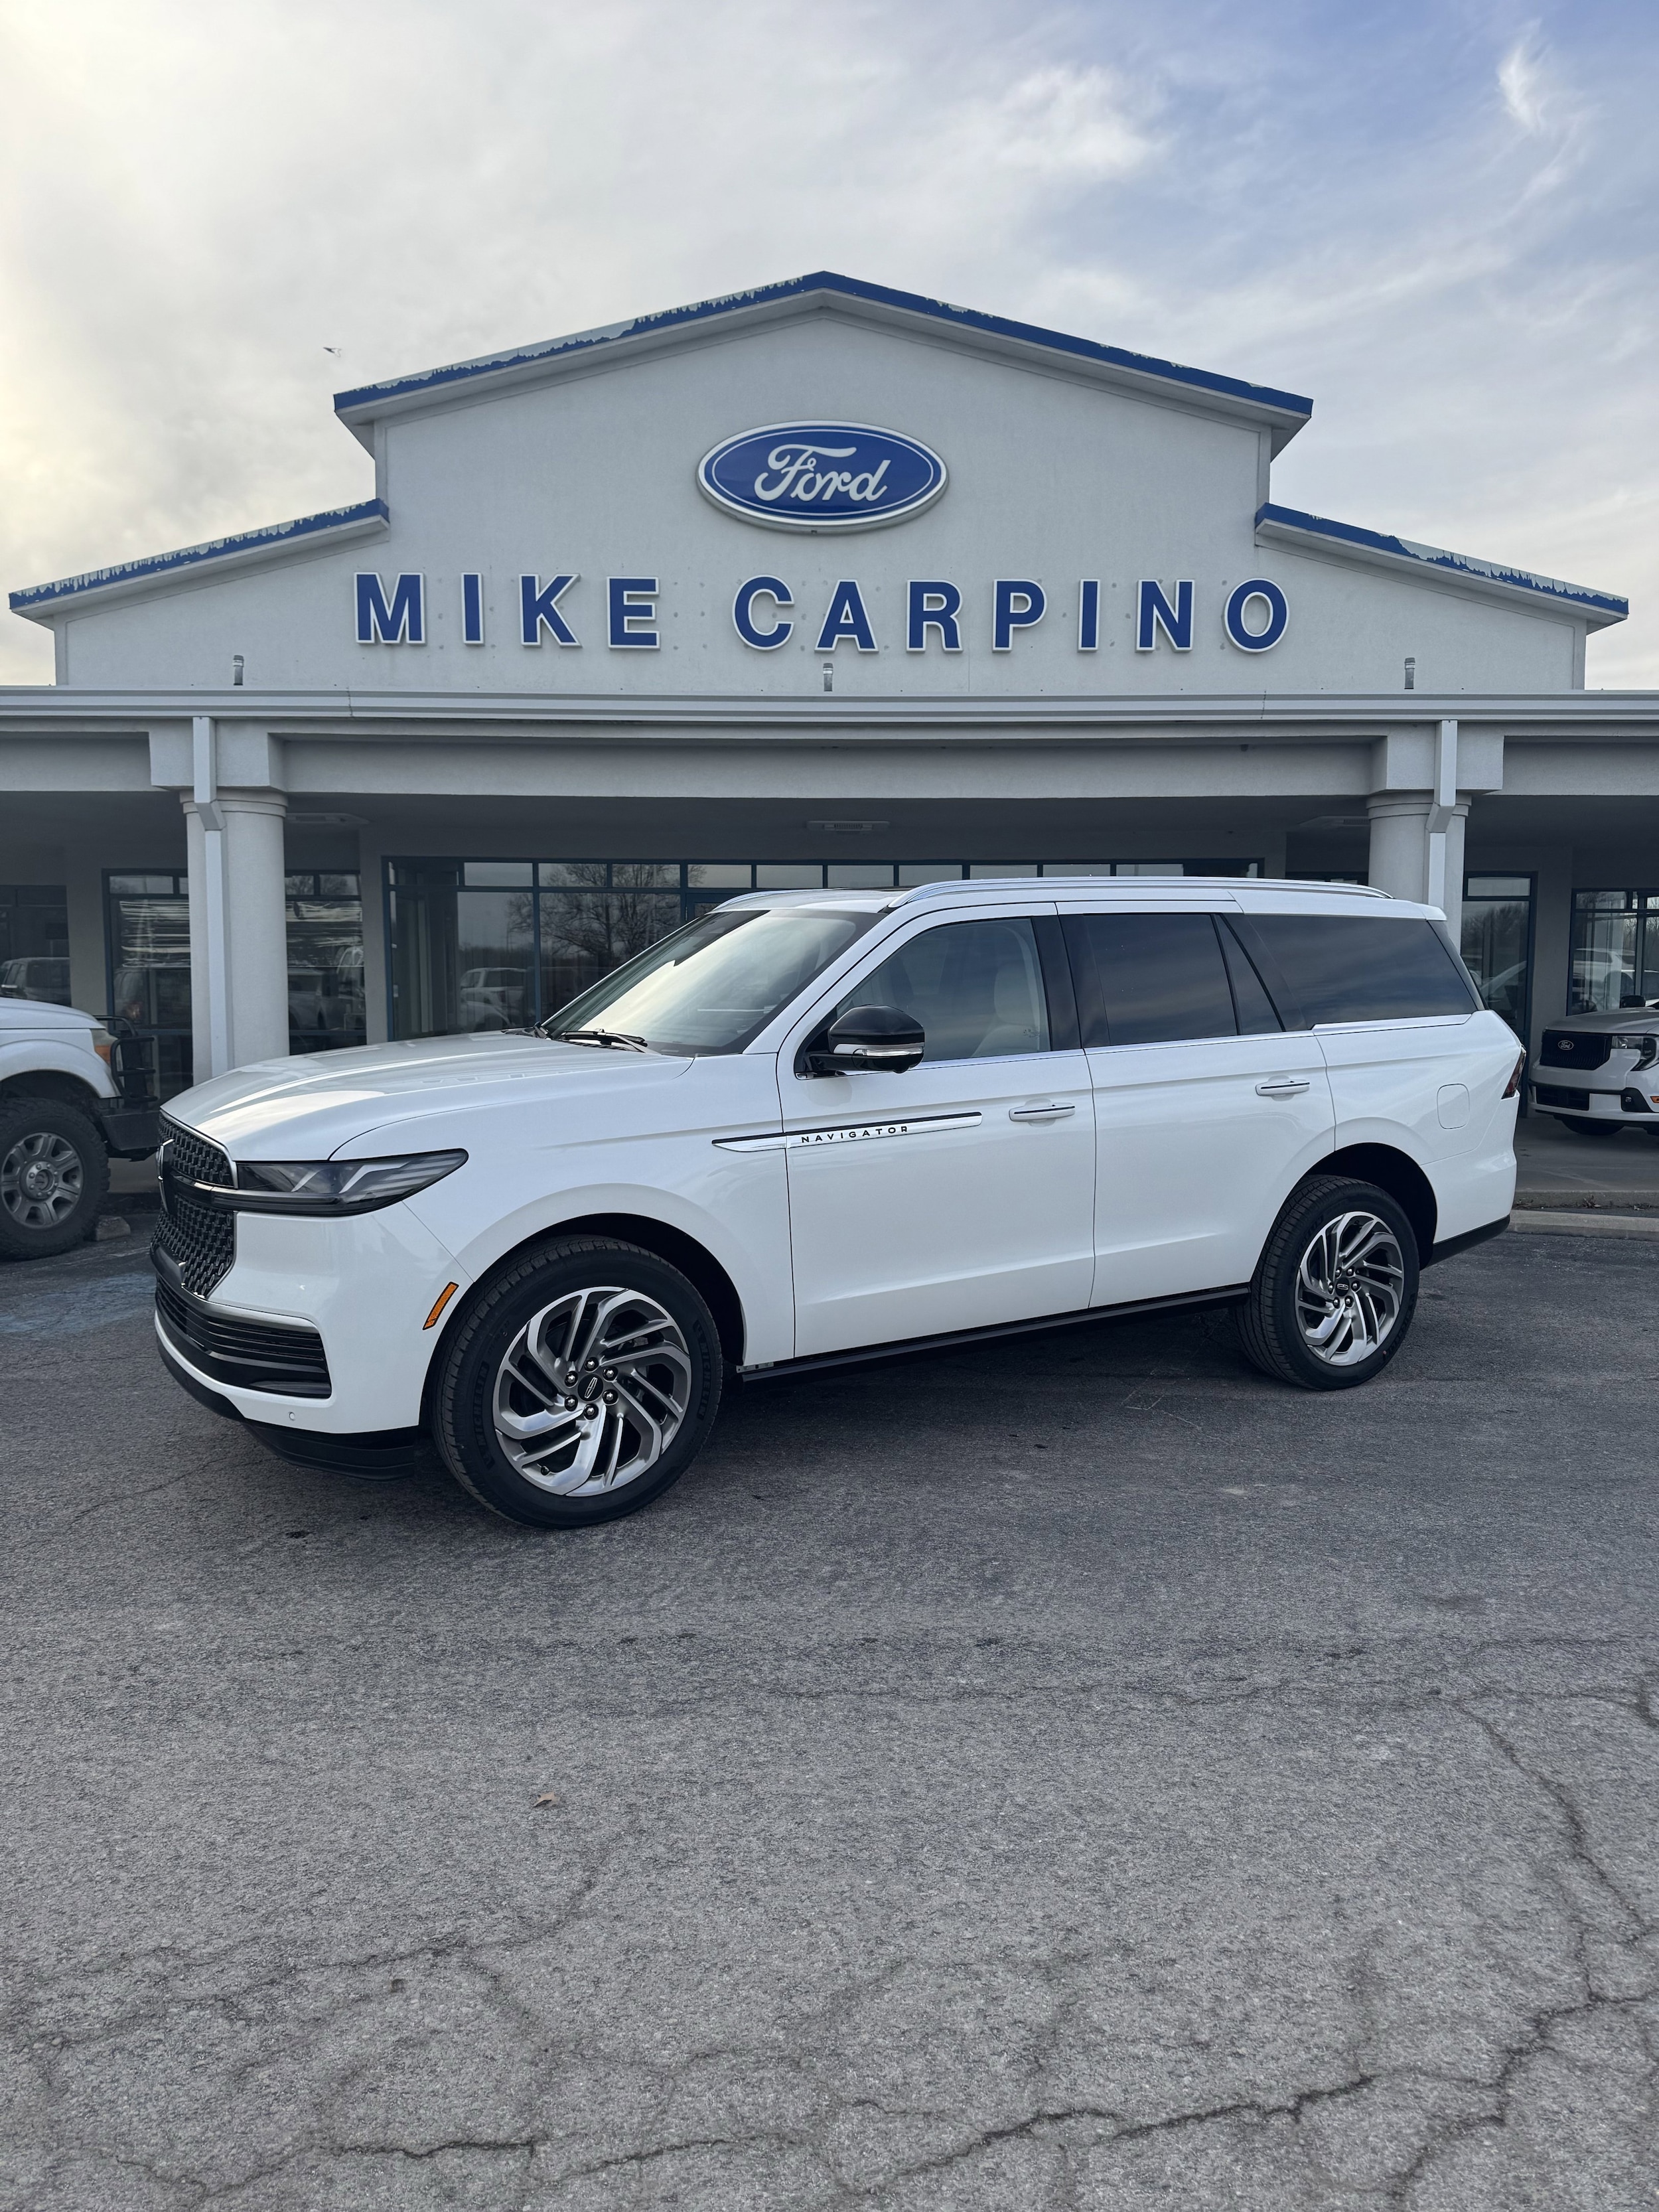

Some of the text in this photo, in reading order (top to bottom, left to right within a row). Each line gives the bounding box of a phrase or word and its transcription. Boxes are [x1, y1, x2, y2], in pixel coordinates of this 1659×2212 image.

[755, 444, 891, 501] Ford
[354, 572, 1289, 653] MIKE CARPINO
[801, 1126, 908, 1143] NAVIGATOR
[474, 1366, 489, 1447] MICHELIN
[698, 1342, 711, 1416] MICHELIN
